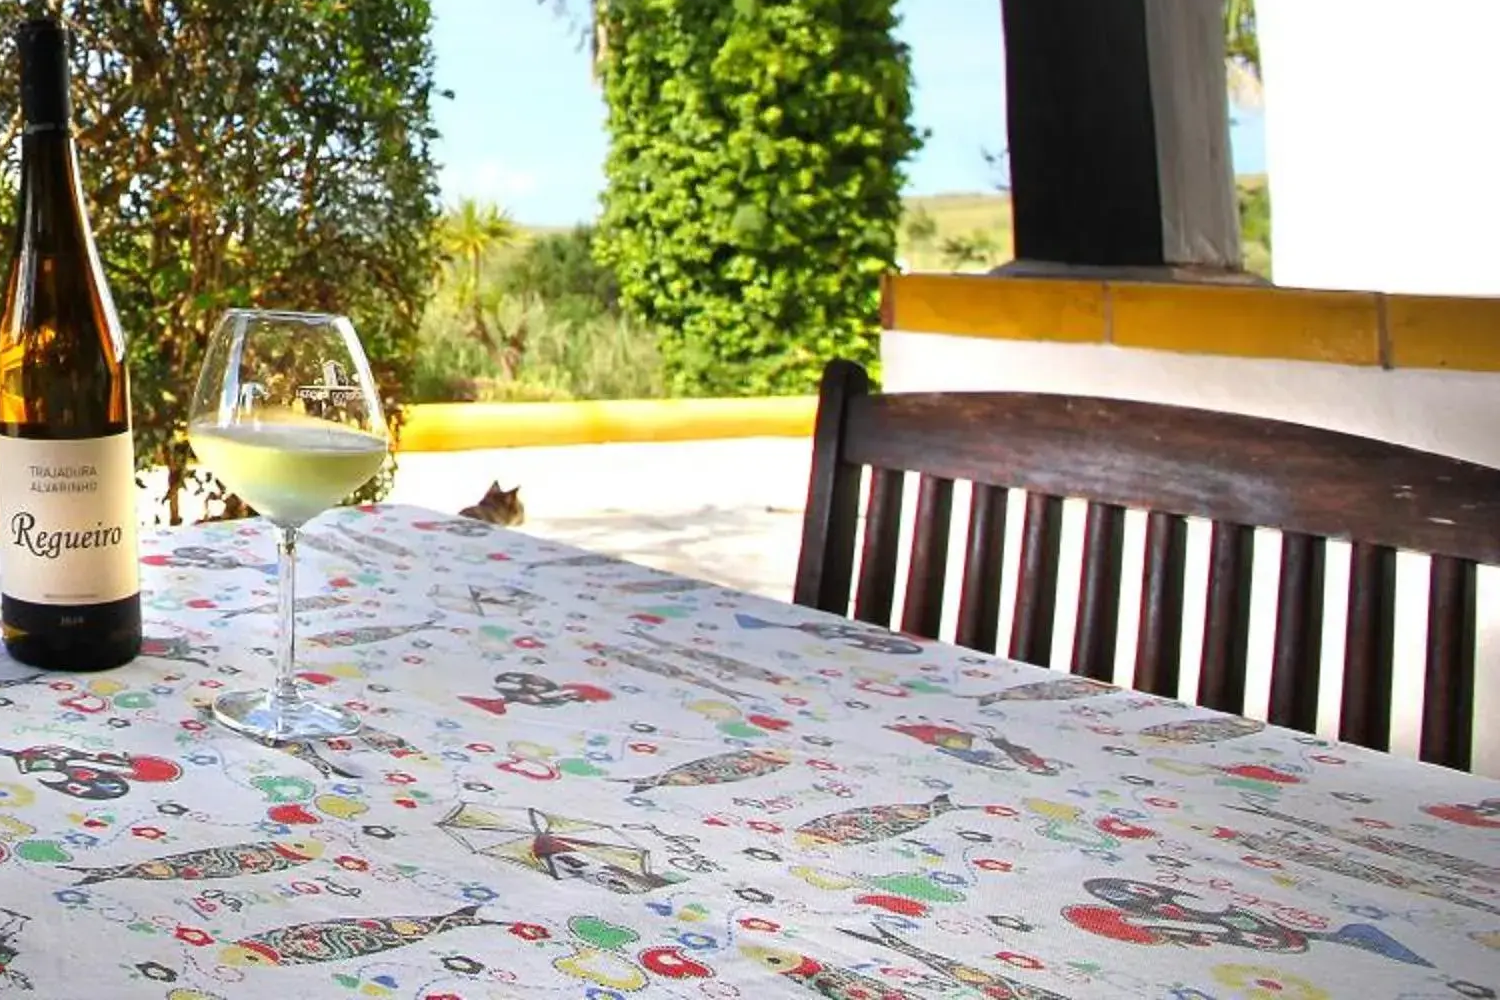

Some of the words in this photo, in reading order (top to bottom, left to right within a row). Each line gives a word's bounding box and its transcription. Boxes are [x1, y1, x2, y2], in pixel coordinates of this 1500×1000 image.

[29, 465, 98, 478] TRAJADURA
[29, 481, 98, 493] ALVARINHO
[11, 511, 123, 559] Regueiro
